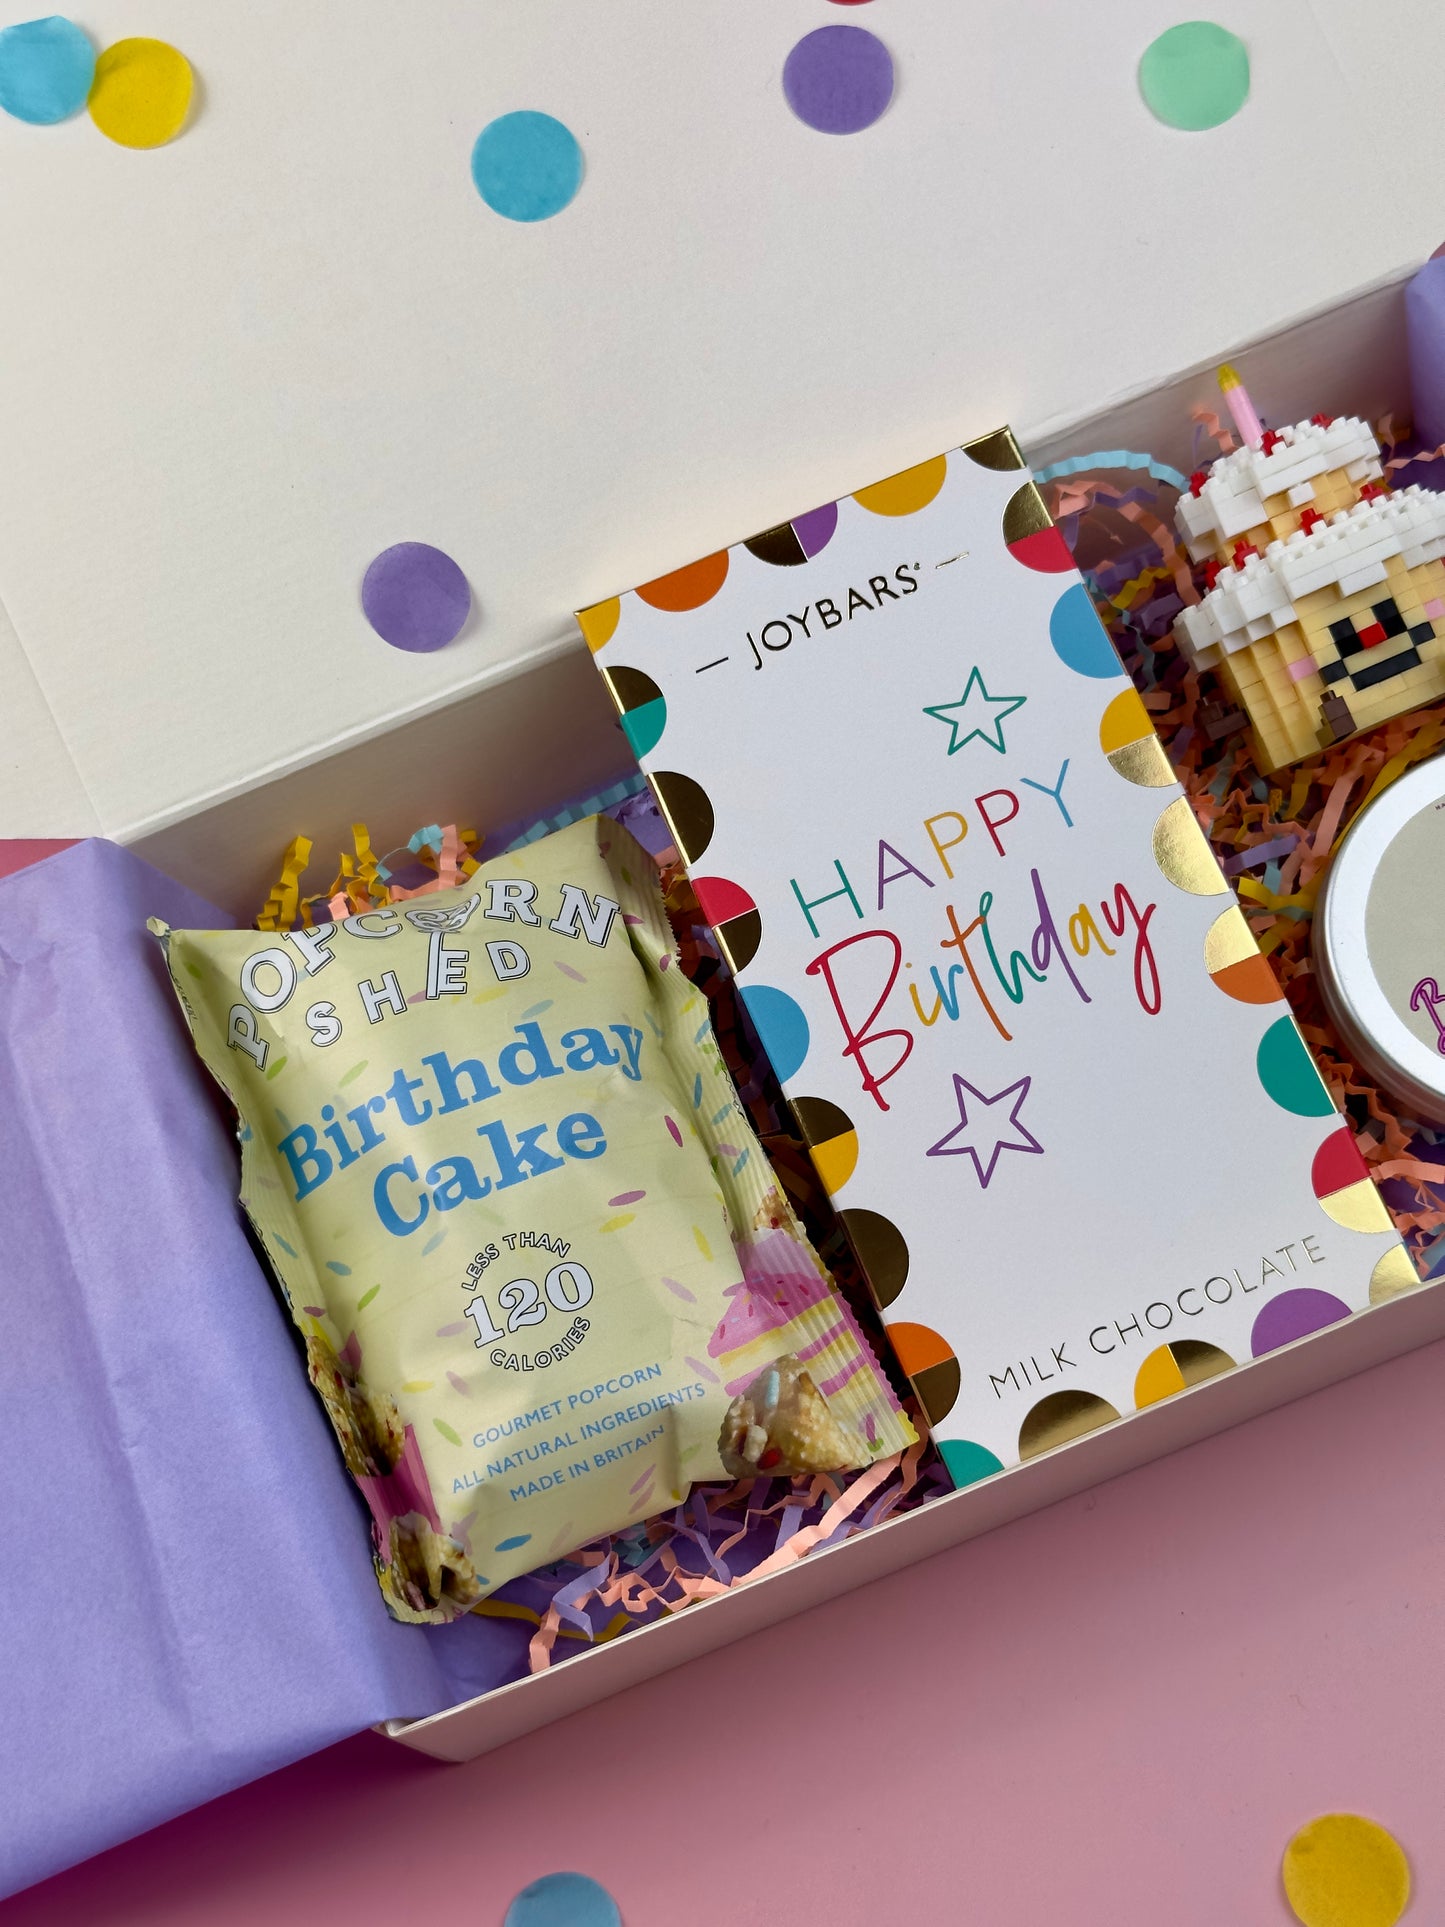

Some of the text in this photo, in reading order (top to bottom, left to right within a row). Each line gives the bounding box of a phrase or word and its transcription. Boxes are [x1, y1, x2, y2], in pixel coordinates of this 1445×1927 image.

[789, 758, 1074, 938] HAPPY
[305, 933, 531, 1047] SHED
[805, 867, 1162, 1111] Birthday
[277, 1021, 644, 1203] Birthday
[373, 1111, 608, 1237] Cake
[462, 1230, 571, 1292] LESS THAN
[463, 1261, 594, 1349] 120
[988, 1234, 1326, 1399] MILK CHOCOLATE
[490, 1315, 591, 1372] CALORIES
[452, 1382, 706, 1494] ALL NATURAL INGREDIENTS
[472, 1362, 663, 1449] GOURMET POPCORN
[508, 1424, 666, 1502] MADE IN BRITAIN
